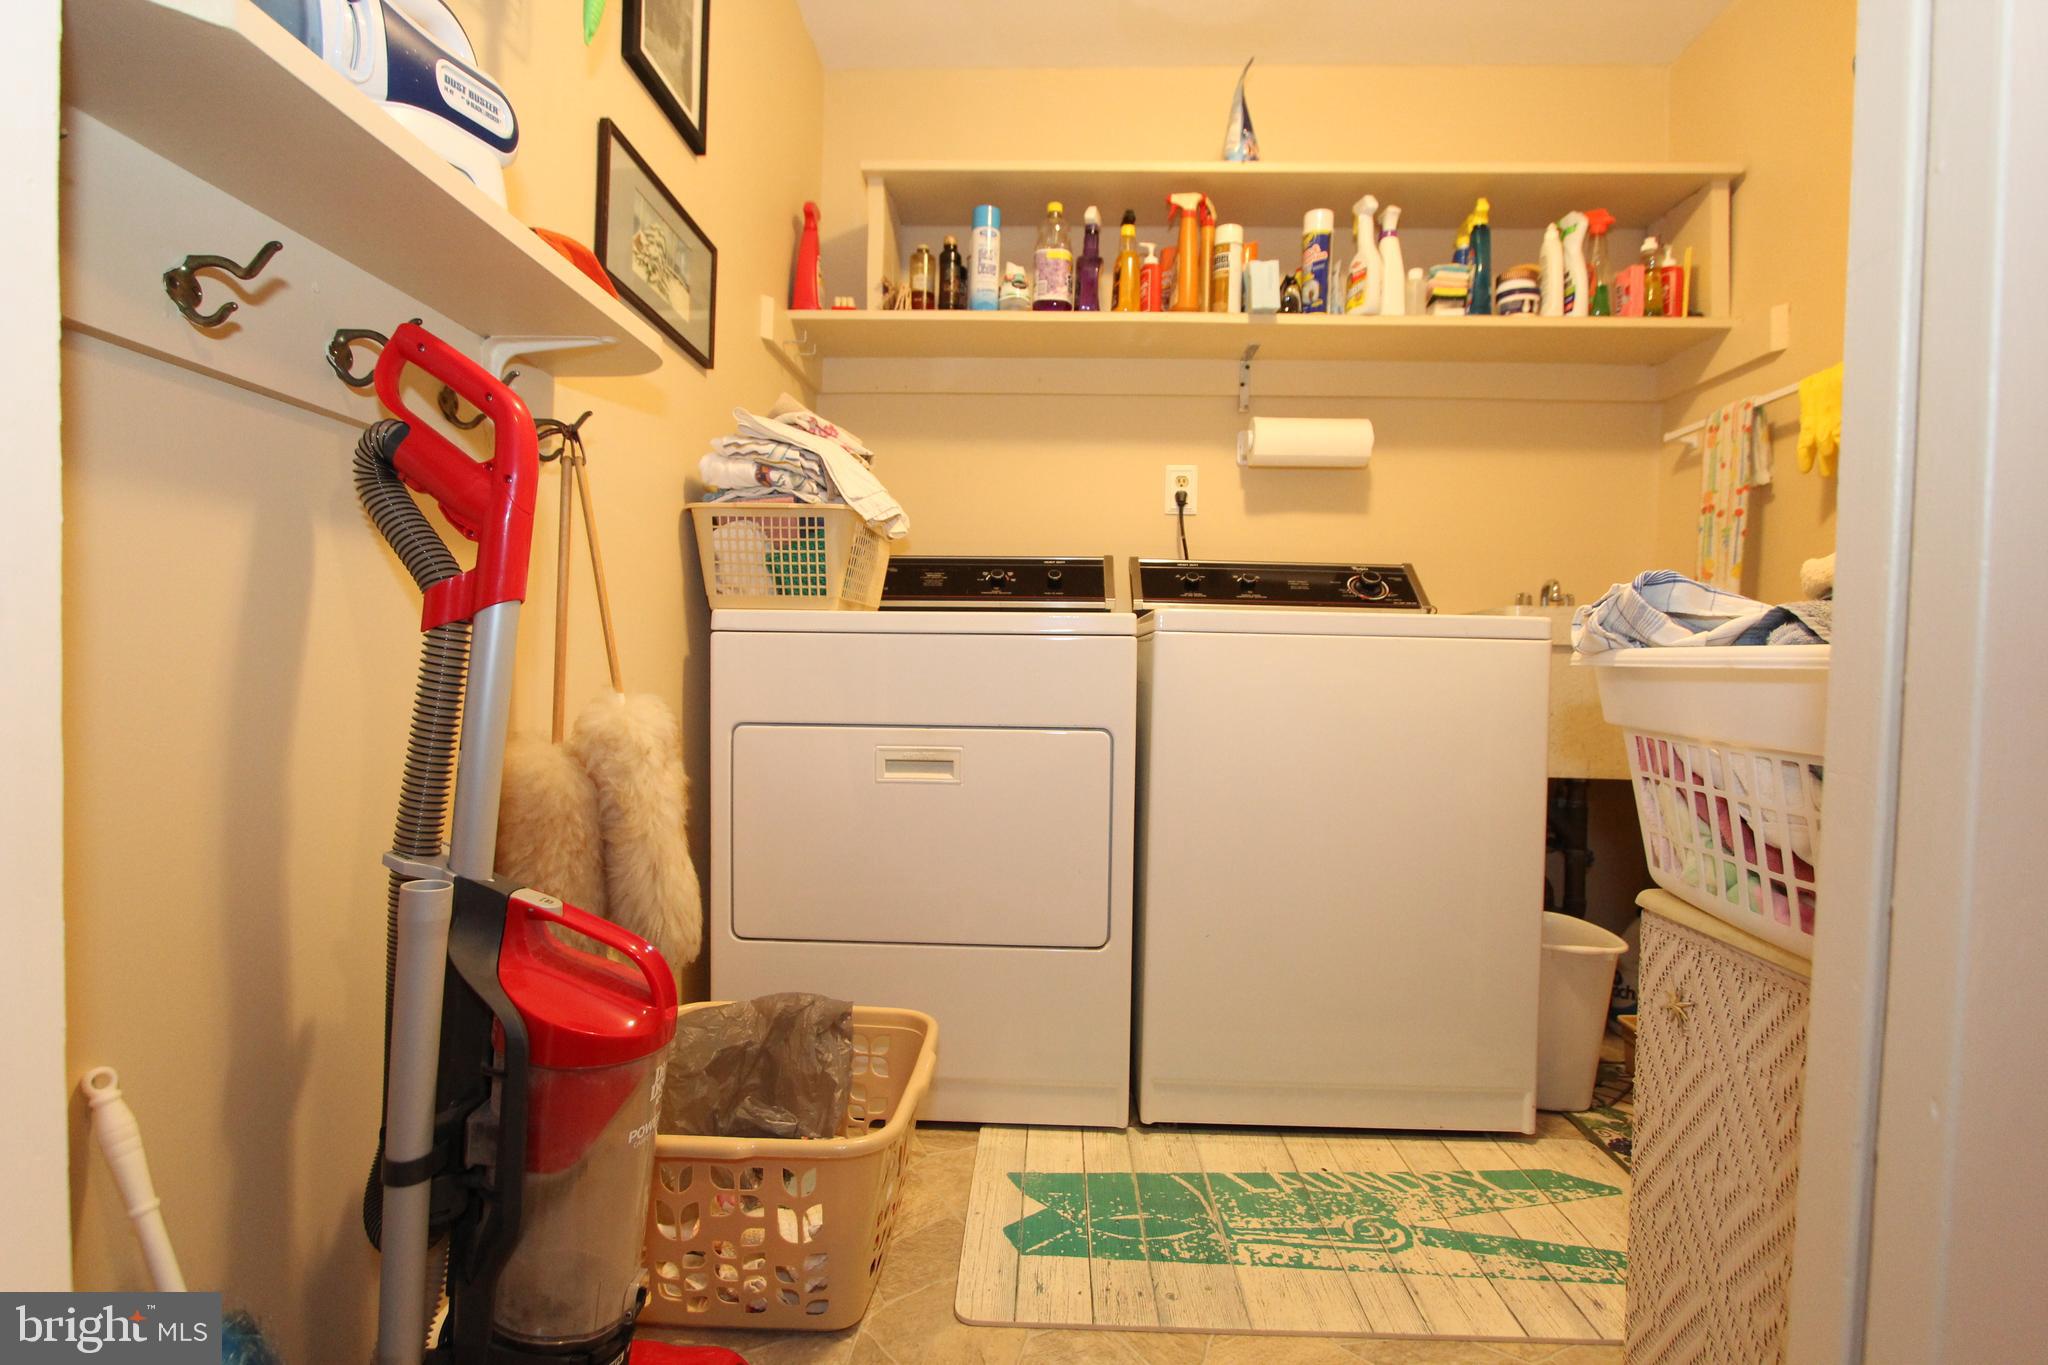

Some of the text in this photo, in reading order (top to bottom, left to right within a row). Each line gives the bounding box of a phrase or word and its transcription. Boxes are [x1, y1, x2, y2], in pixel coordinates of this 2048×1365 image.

[444, 74, 499, 116] DUST BUSTER
[1222, 1170, 1505, 1193] LAUNDRY
